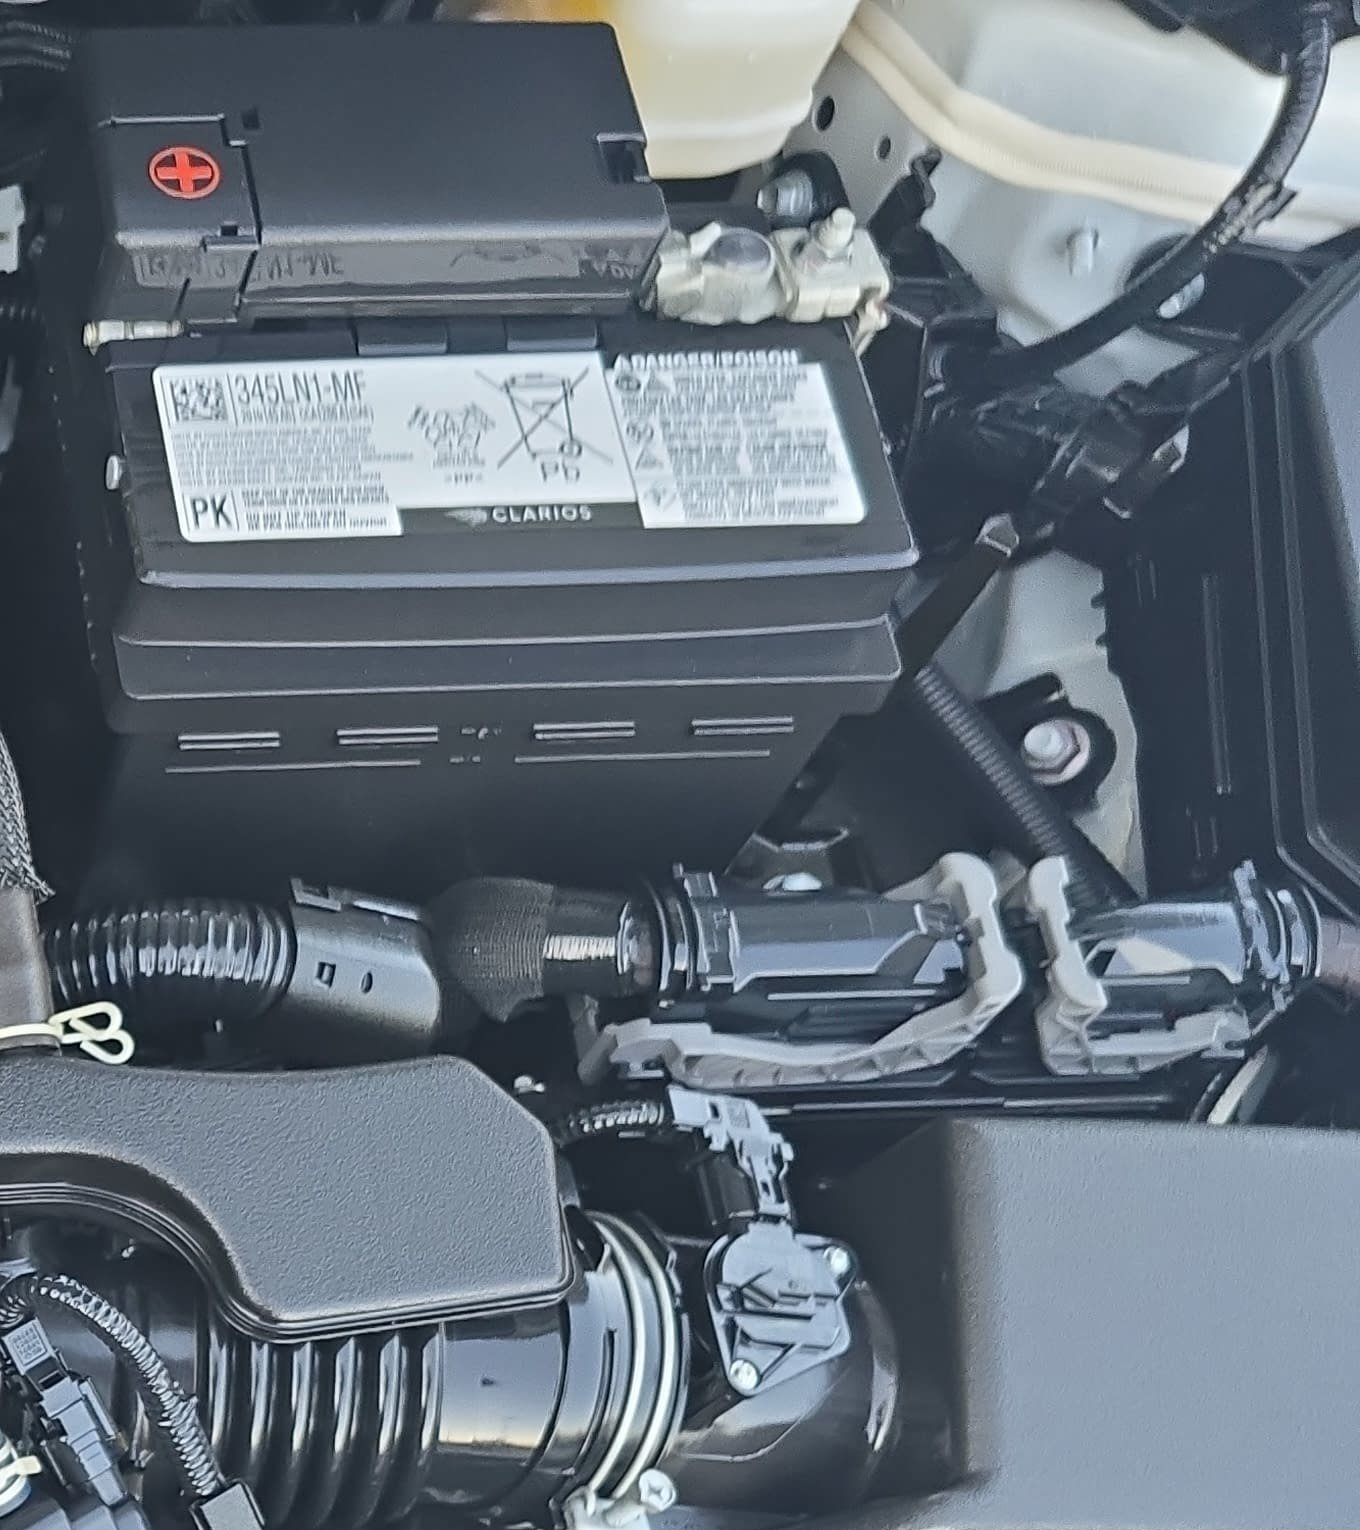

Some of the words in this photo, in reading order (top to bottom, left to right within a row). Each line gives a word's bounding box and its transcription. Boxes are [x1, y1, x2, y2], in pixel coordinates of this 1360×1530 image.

[234, 368, 368, 406] 345LN1-MF
[189, 494, 233, 530] PK
[490, 504, 594, 525] CLARIOS
